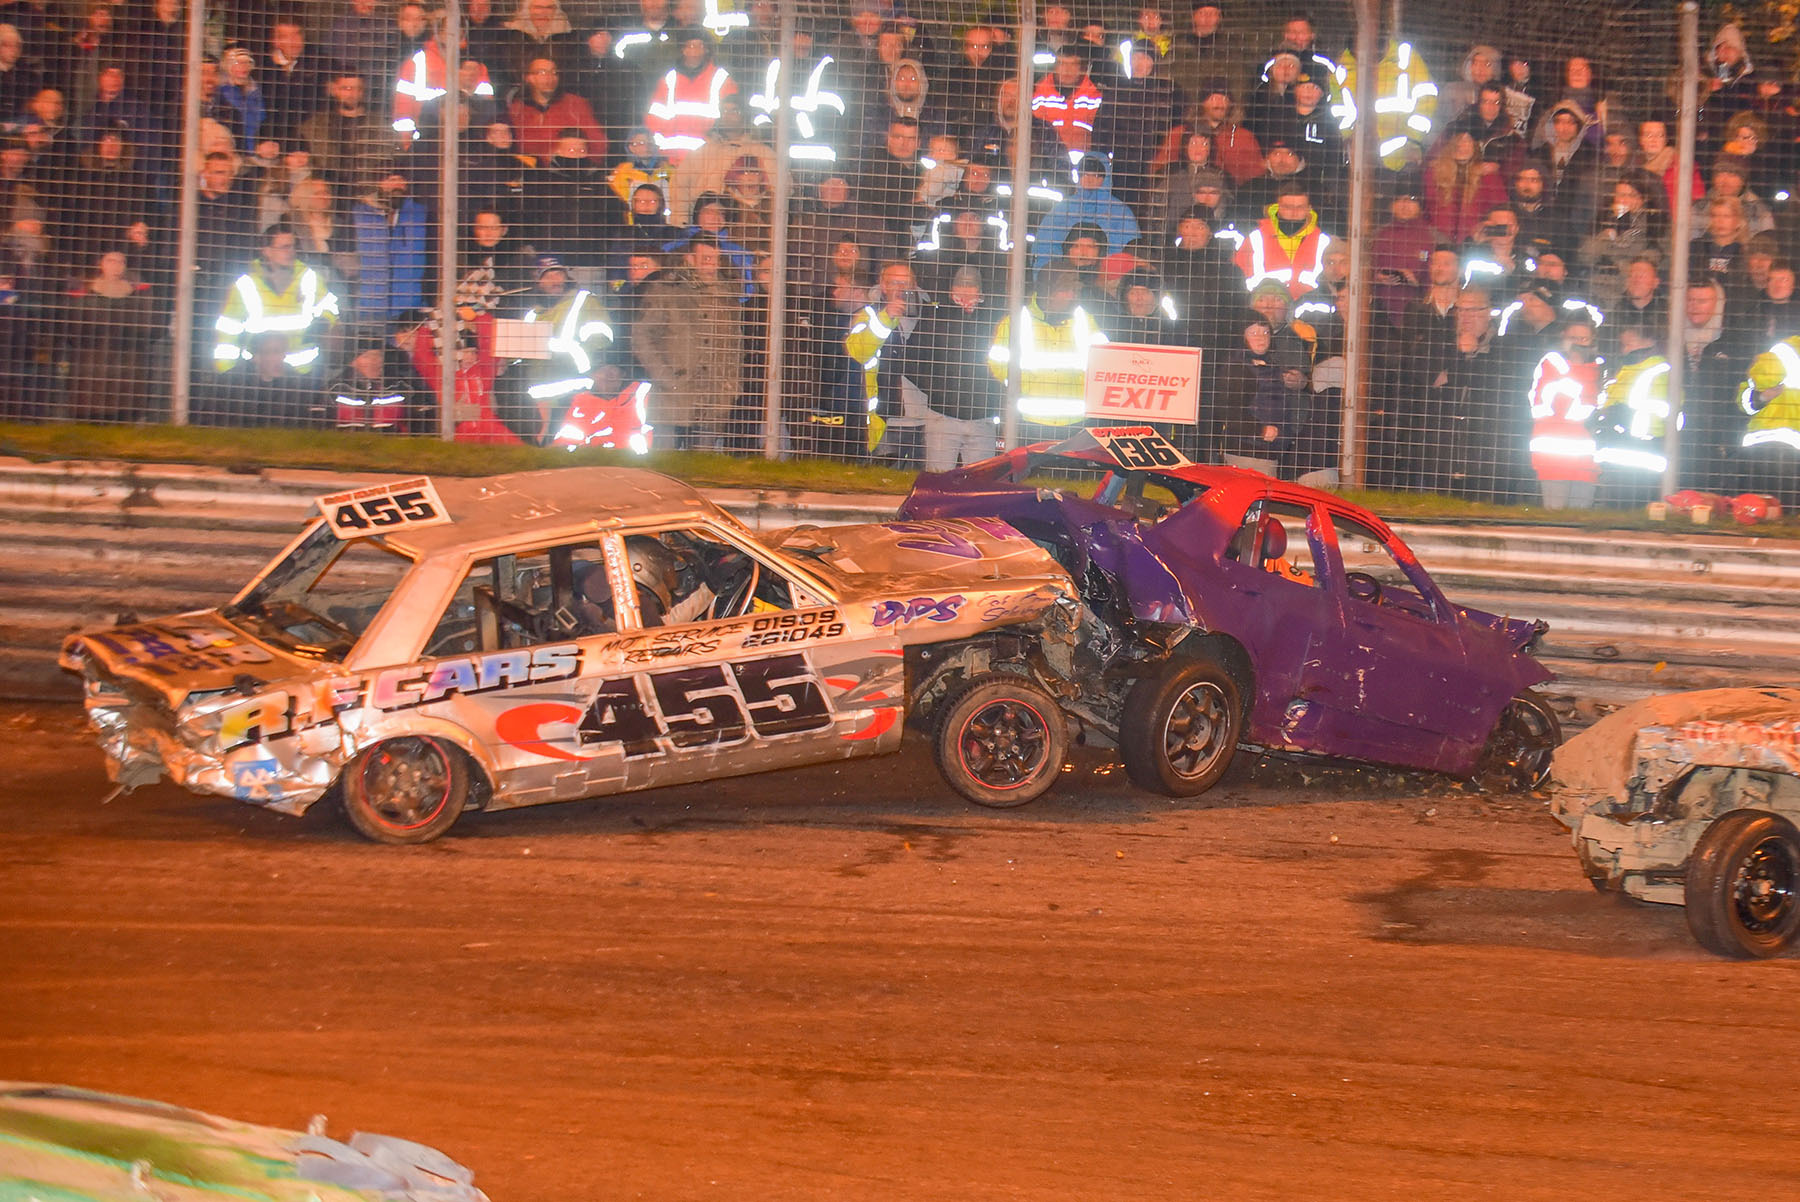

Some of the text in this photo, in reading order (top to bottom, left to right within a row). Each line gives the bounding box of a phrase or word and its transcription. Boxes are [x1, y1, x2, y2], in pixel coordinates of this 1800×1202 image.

[1094, 371, 1191, 388] EMERGENCY
[1102, 386, 1178, 411] EXIT
[1107, 437, 1181, 468] 136
[335, 491, 438, 529] 455
[752, 609, 838, 632] 01909
[872, 594, 968, 628] DPS
[600, 635, 648, 653] MOT
[652, 622, 748, 645] SERVICE
[371, 644, 585, 713] CARS
[576, 651, 835, 761] 455
